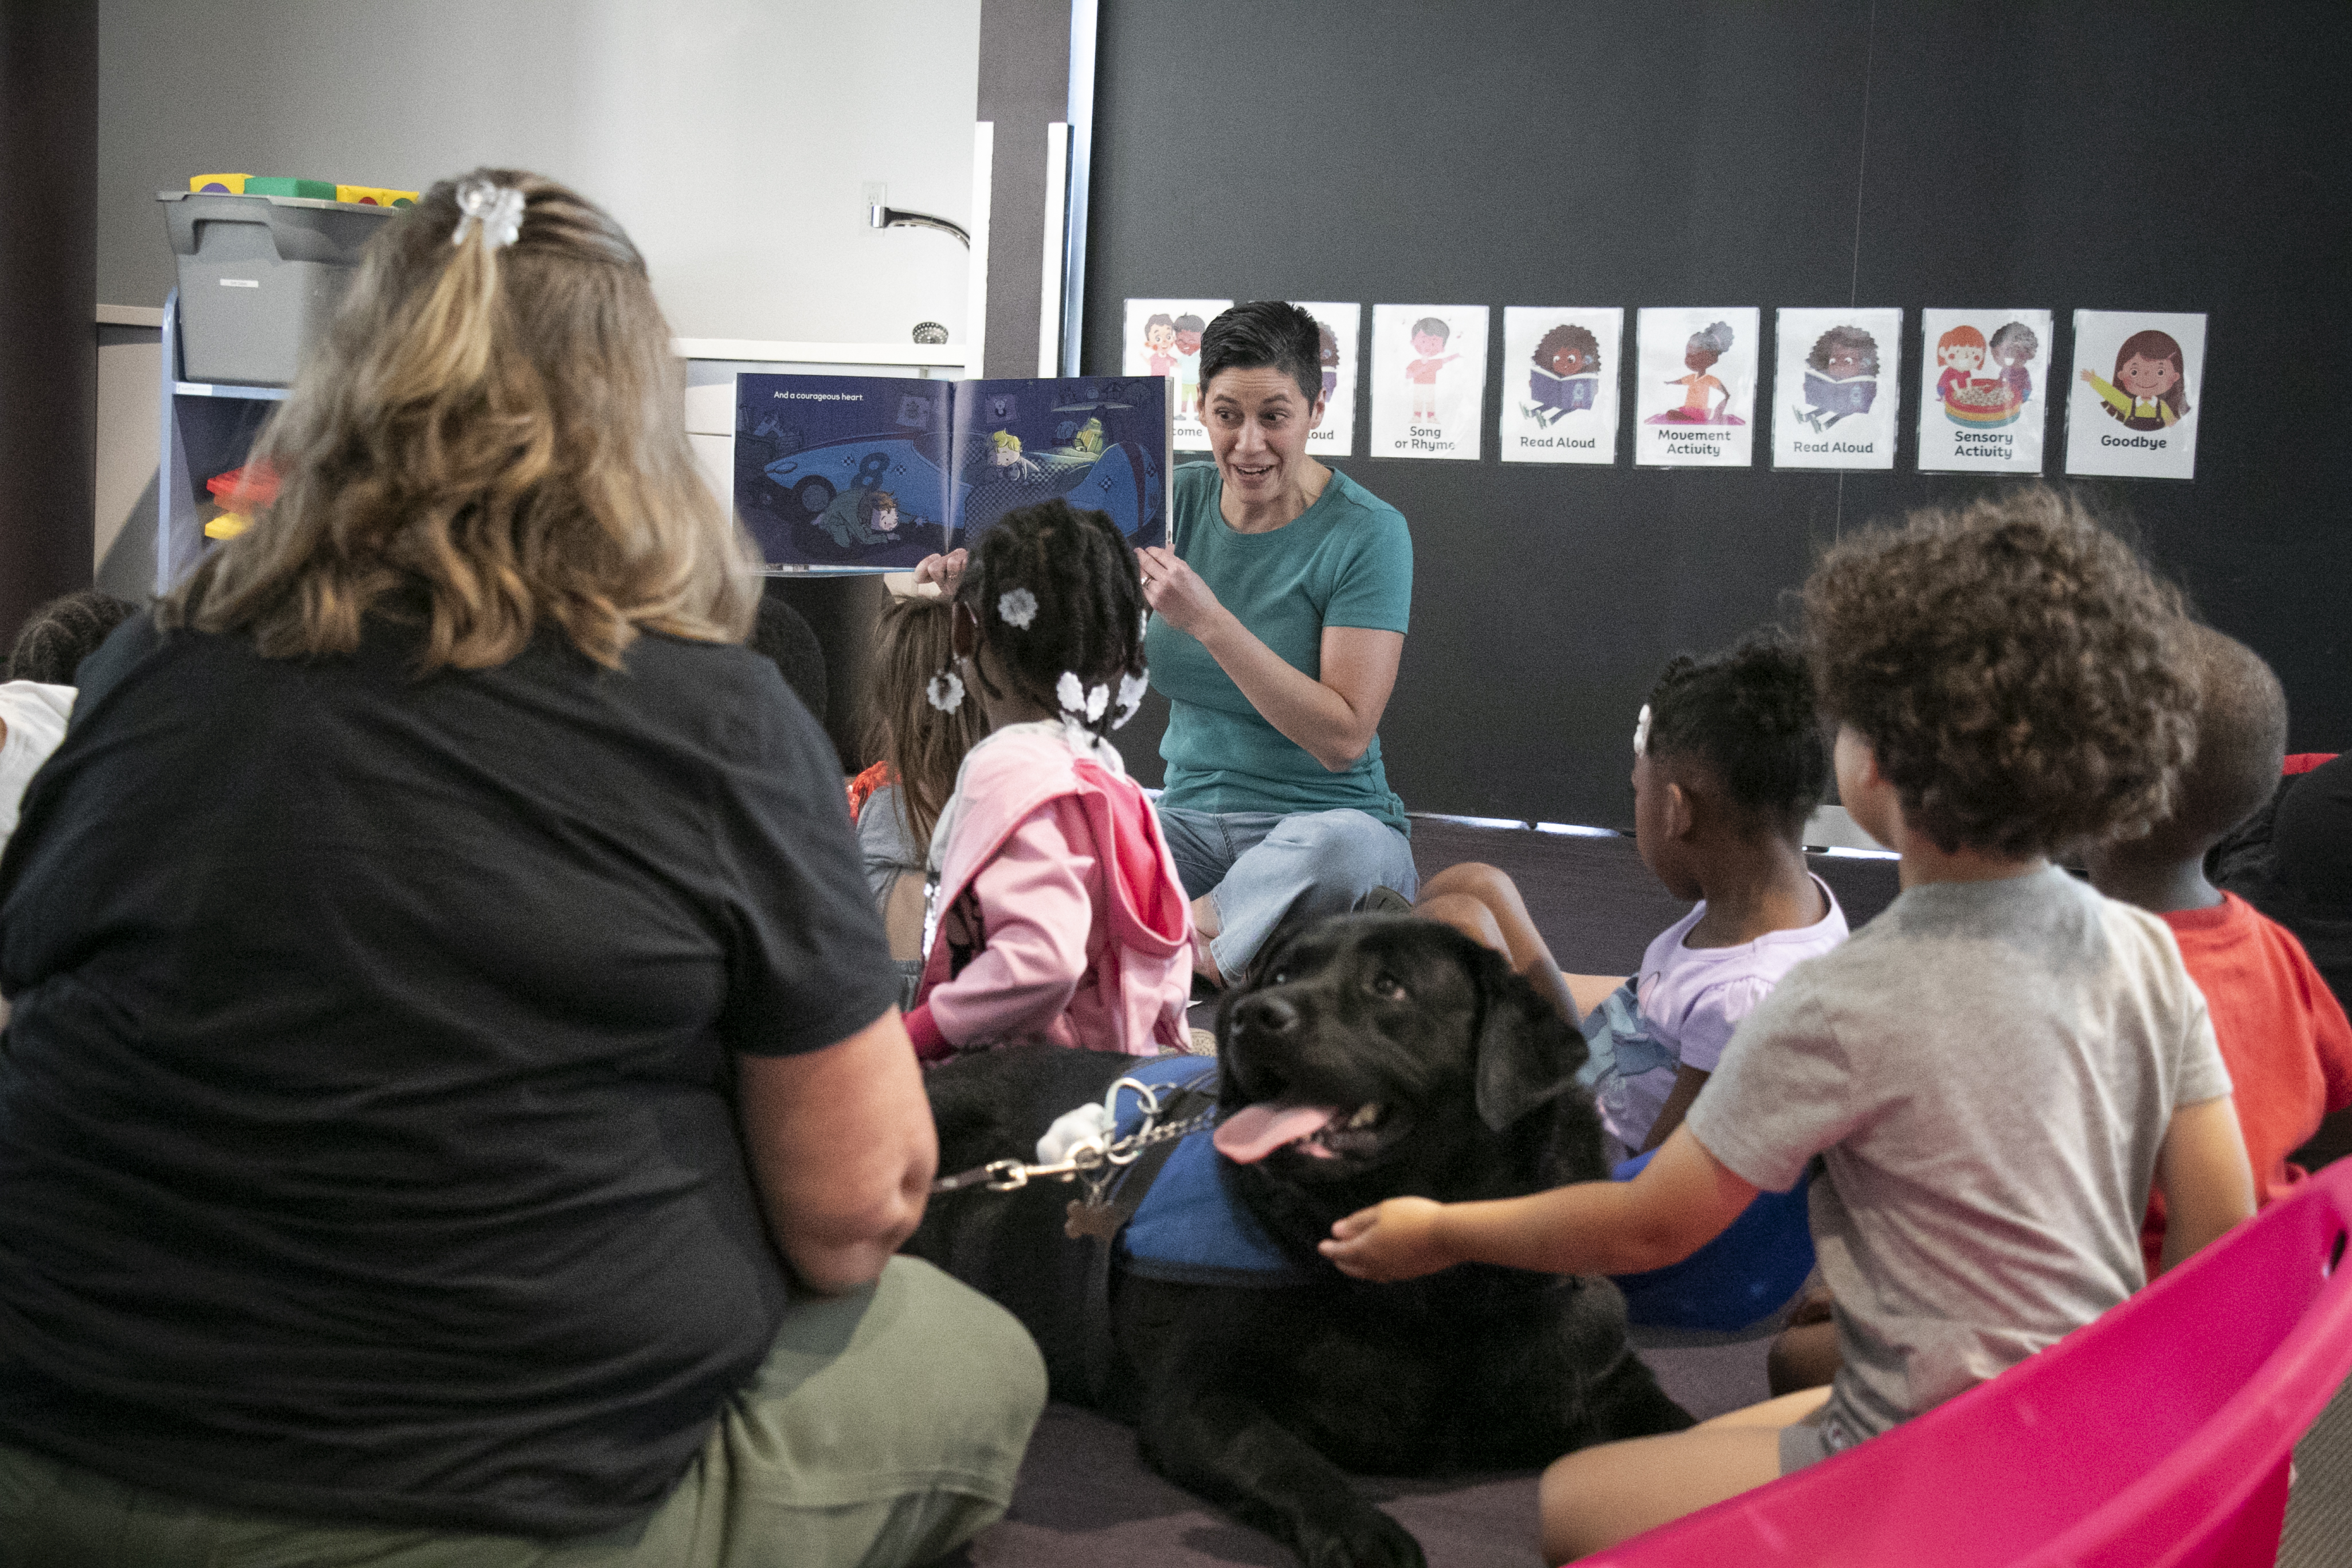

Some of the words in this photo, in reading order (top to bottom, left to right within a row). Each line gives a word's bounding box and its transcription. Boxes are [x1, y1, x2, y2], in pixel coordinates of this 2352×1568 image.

[774, 391, 789, 399] And
[796, 393, 840, 401] courageous
[841, 393, 864, 401] heart.
[1410, 426, 1441, 439] Song
[1658, 429, 1731, 441] Movement
[1954, 431, 2013, 445] Sensory
[1394, 440, 1408, 448] or
[1411, 439, 1456, 452] Rhyme
[1520, 436, 1553, 447] Read
[1556, 437, 1596, 448] Aloud
[1793, 441, 1829, 452] Read
[1832, 442, 1873, 453] Aloud
[2101, 435, 2167, 450] Goodbye
[1667, 443, 1720, 457] Activity
[1954, 445, 2013, 460] Activity
